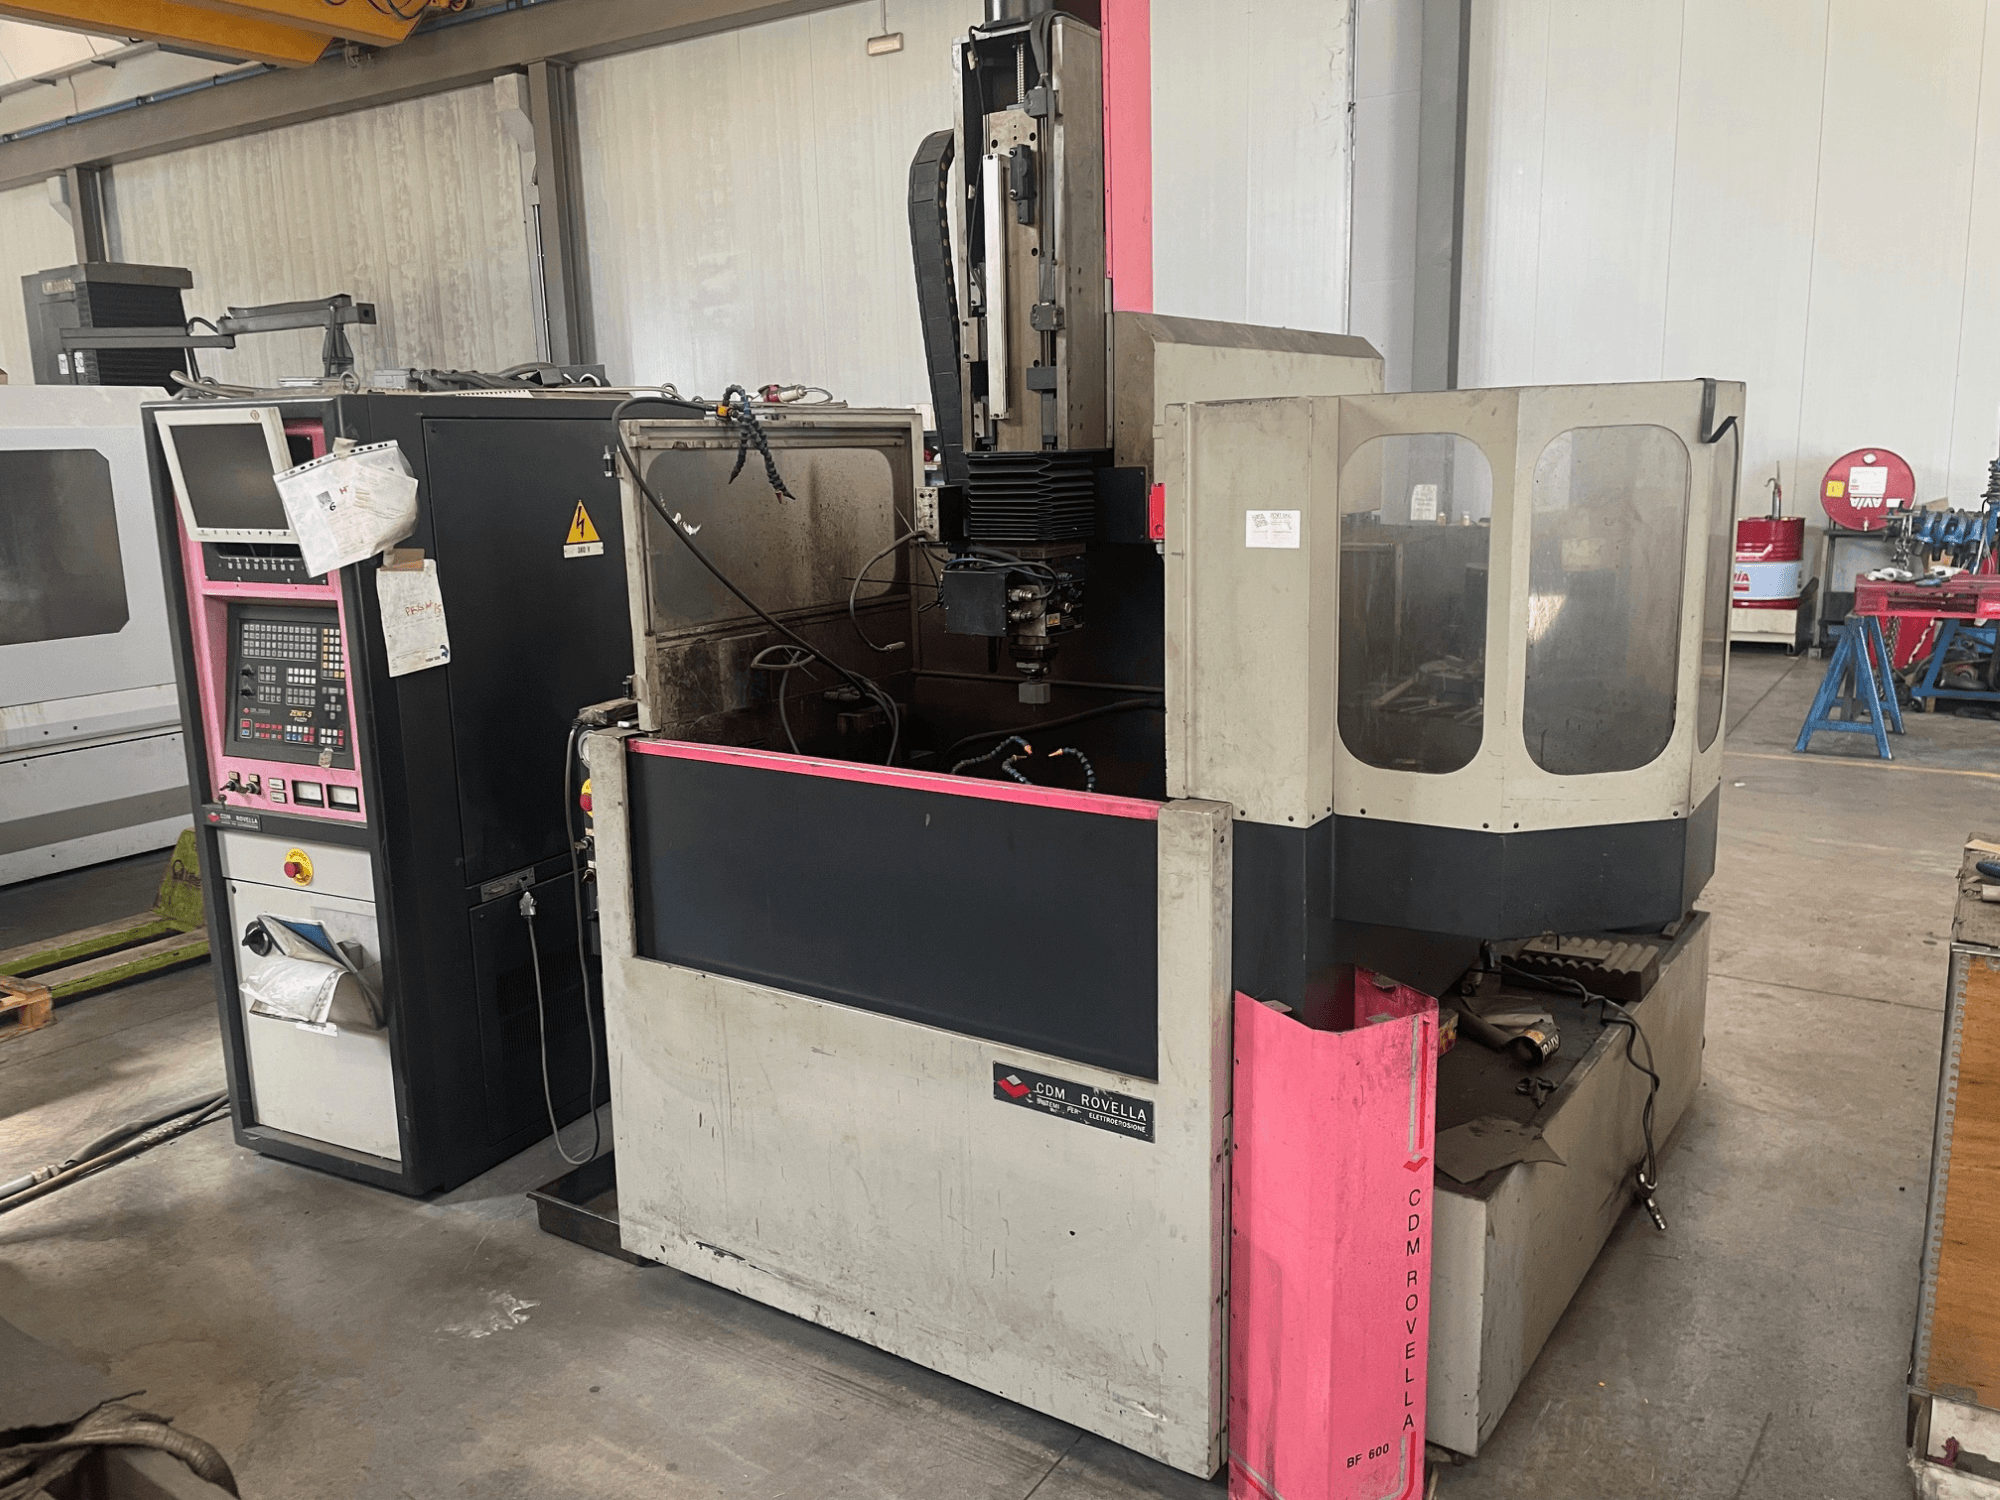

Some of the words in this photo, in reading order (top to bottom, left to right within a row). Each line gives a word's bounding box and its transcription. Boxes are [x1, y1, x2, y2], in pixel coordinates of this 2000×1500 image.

[235, 815, 258, 824] ROVELLA
[1036, 1082, 1065, 1100] CDM
[1081, 1094, 1147, 1122] ROVELLA
[1066, 1105, 1079, 1115] PER
[1088, 1112, 1146, 1133] ELETTROEROSIONE
[1406, 1188, 1421, 1255] CDM
[1402, 1270, 1419, 1431] ROVELLA
[1346, 1453, 1362, 1468] BF
[1368, 1443, 1389, 1460] 600
